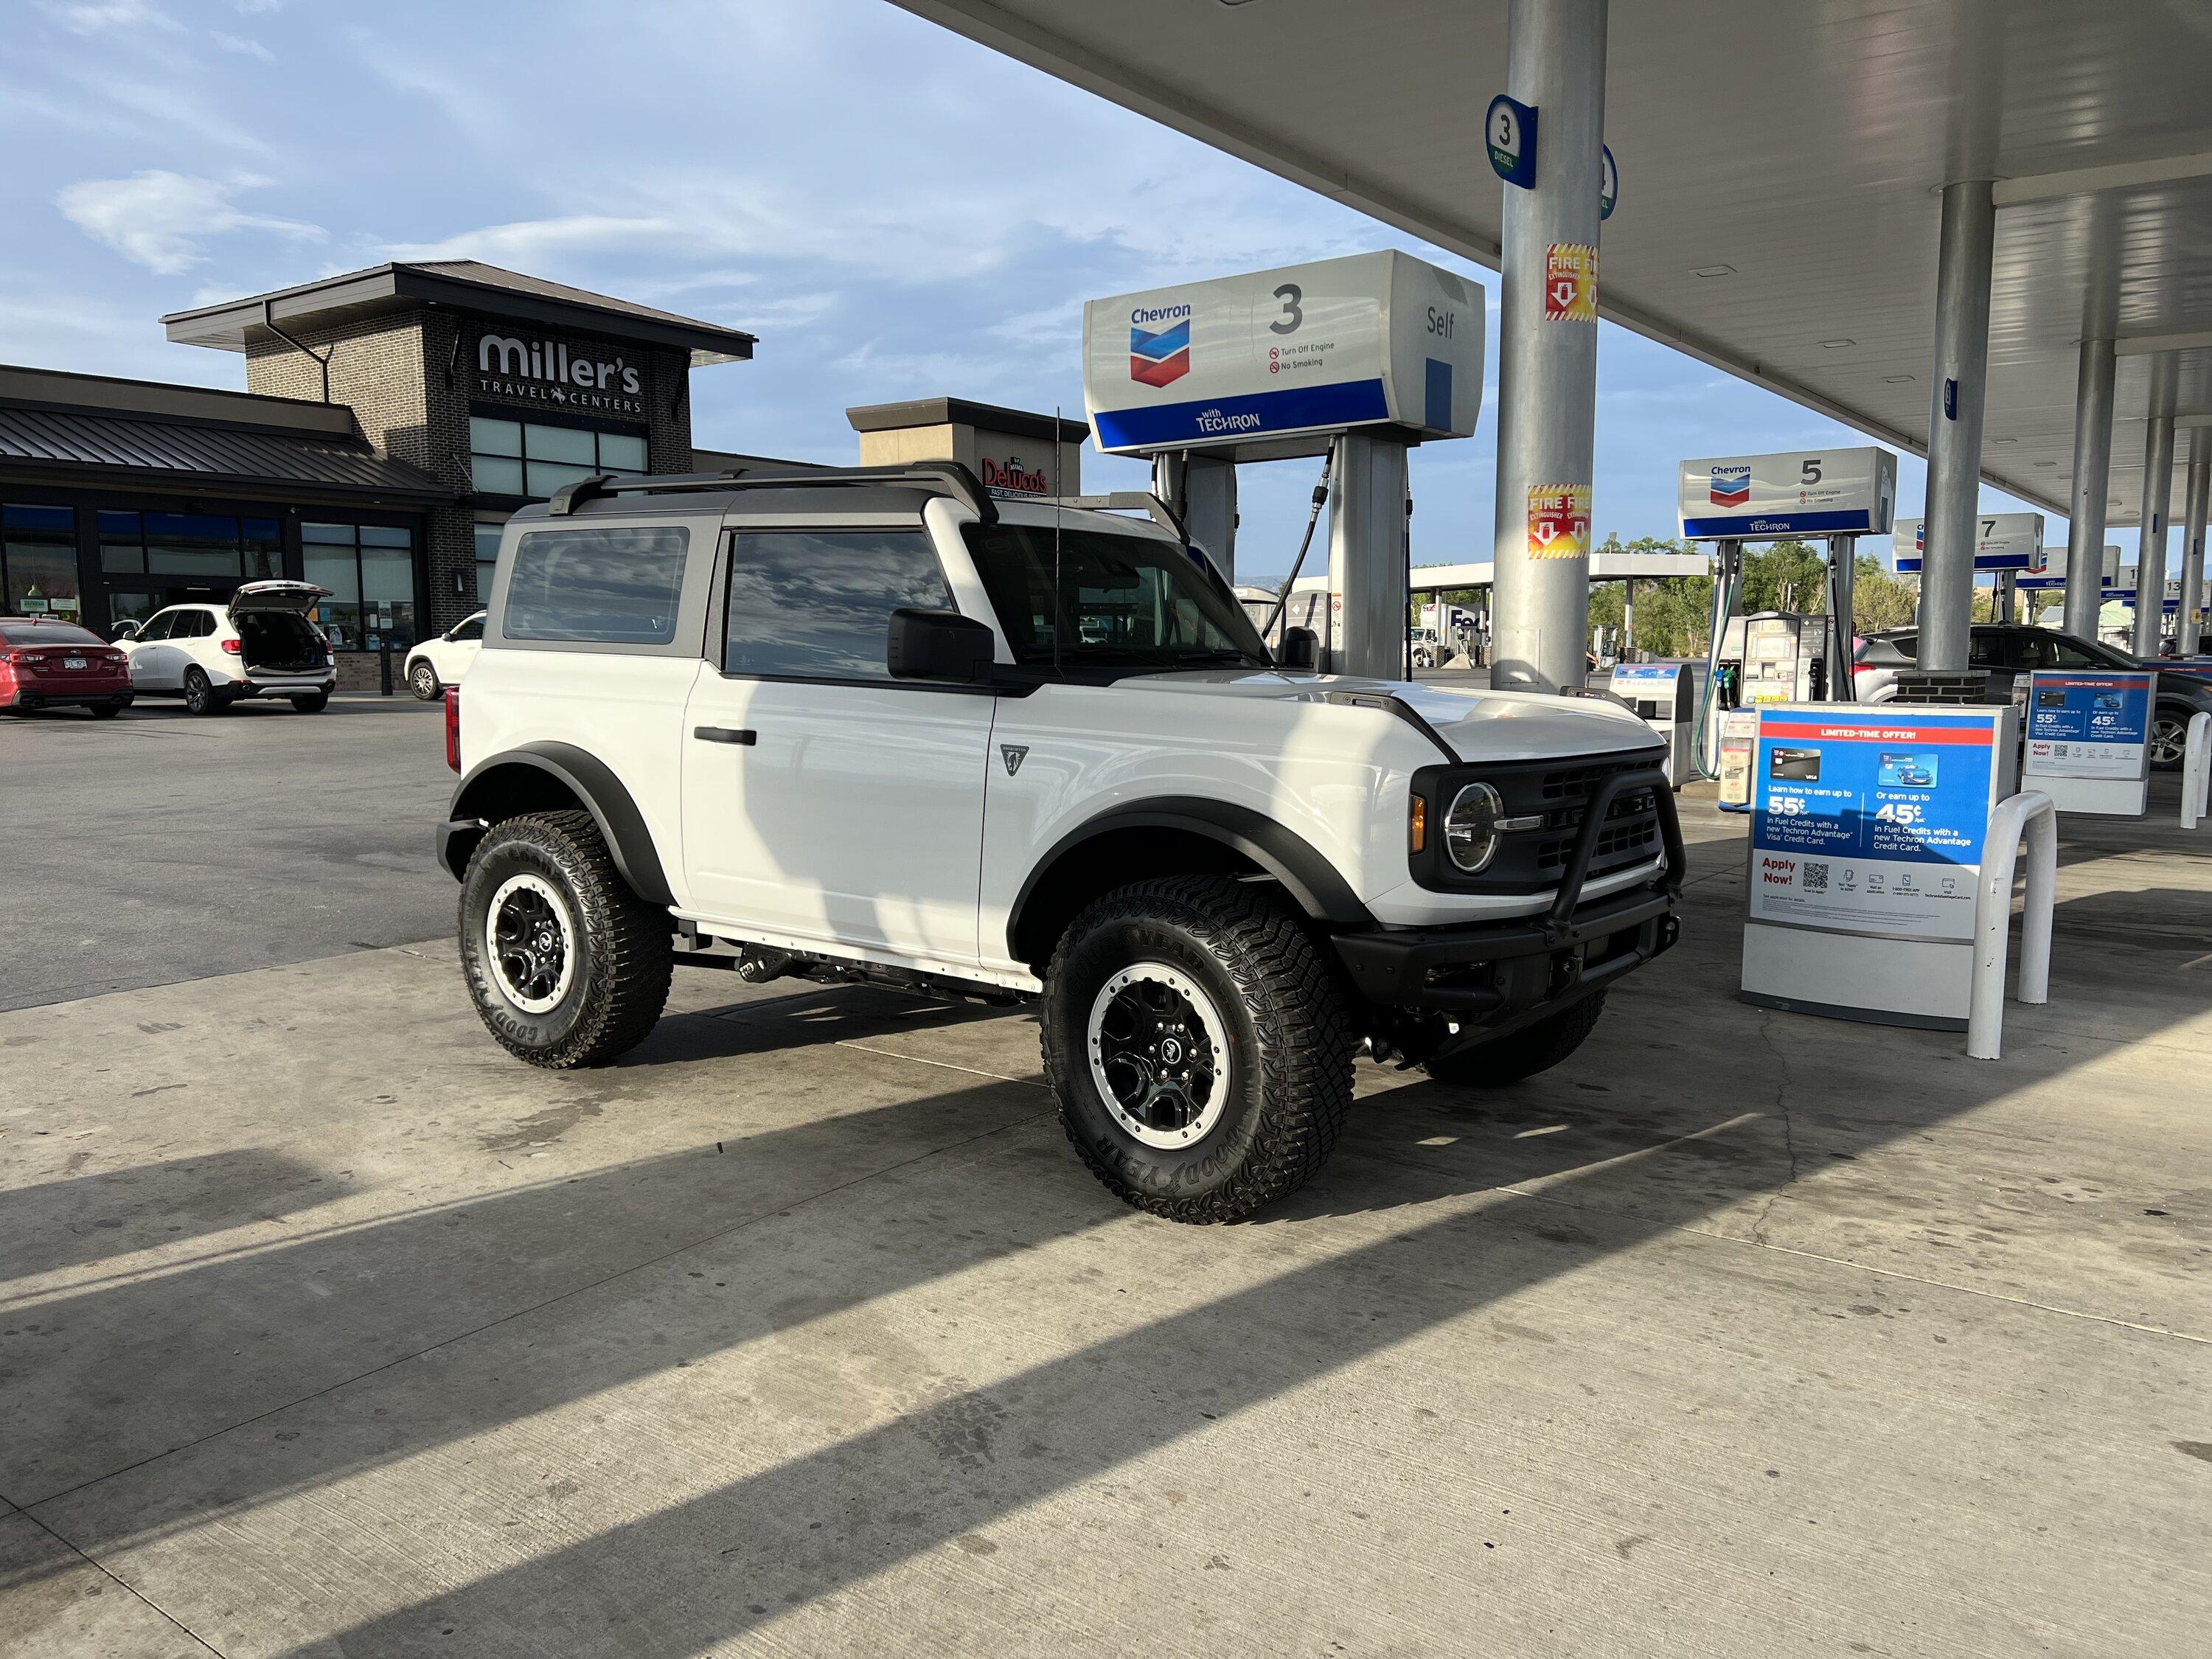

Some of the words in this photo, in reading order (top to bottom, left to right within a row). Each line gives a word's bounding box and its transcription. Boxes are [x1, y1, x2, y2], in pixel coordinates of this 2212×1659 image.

[1499, 114, 1511, 146] 3
[1495, 150, 1514, 167] DIESEL
[1549, 257, 1581, 270] FIRE
[1548, 271, 1580, 280] EXTINGUISHER
[1131, 304, 1191, 324] Chevron
[1270, 284, 1303, 335] 3
[1427, 306, 1454, 339] Self
[1298, 345, 1309, 353] Off
[1311, 342, 1335, 352] Engine
[1293, 359, 1323, 369] Smoking
[481, 379, 547, 400] TRAVEL
[570, 392, 641, 413] CENTERS
[1202, 408, 1222, 418] with
[1195, 413, 1261, 432] TECHRON
[1711, 466, 1750, 475] Chevron
[1801, 459, 1822, 485] 5
[1530, 496, 1563, 509] FIRE
[1530, 511, 1563, 521] EXTINGUISHER
[1750, 522, 1790, 532] TECHRON
[1981, 521, 1996, 538] 7
[2168, 582, 2180, 591] 13
[1820, 728, 1879, 739] LIMITED-TIME
[1882, 730, 1916, 740] OFFER!
[1768, 785, 1787, 793] Learn
[1832, 790, 1842, 798] up
[1876, 791, 1887, 799] Or
[1921, 793, 1930, 801] to
[1790, 819, 1814, 827] Credits
[1782, 826, 1809, 835] Techron
[1884, 825, 1900, 833] Fuel
[1902, 827, 1931, 835] Credits
[1933, 828, 1950, 836] with
[1784, 835, 1804, 844] Credit
[1806, 837, 1825, 845] Card.
[1893, 835, 1924, 844] Techron
[1927, 836, 1972, 847] Advantage
[1874, 842, 1897, 851] Credit
[1899, 844, 1921, 852] Card.
[1762, 857, 1796, 872] Apply
[1764, 872, 1792, 885] Now!
